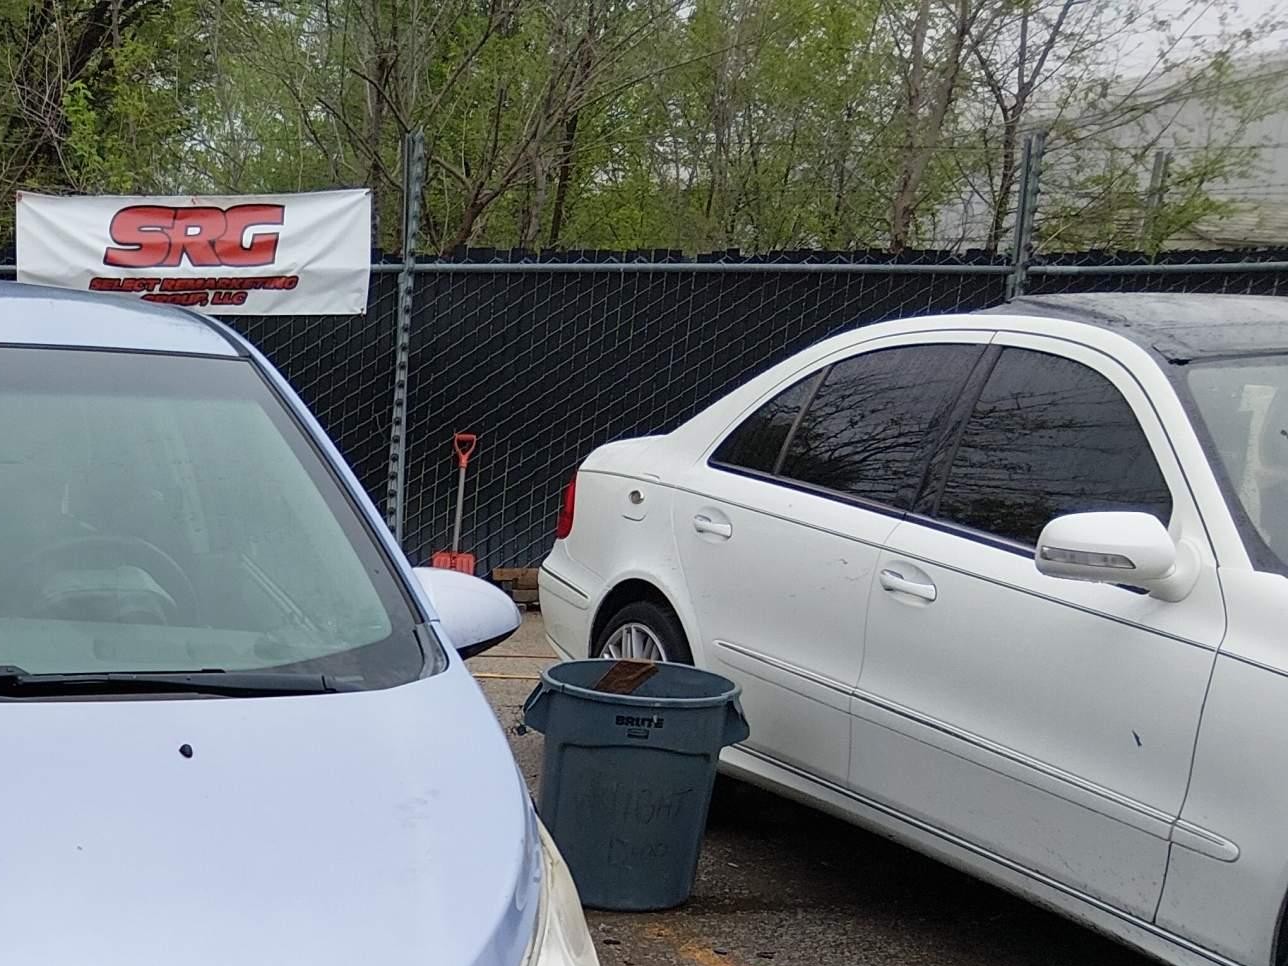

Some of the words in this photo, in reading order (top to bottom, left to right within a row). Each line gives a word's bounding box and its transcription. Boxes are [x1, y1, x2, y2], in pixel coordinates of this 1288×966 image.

[103, 204, 285, 268] SRG
[89, 277, 161, 291] SELECT
[159, 275, 299, 290] REMARKETING
[210, 291, 248, 305] LLC
[615, 715, 664, 728] BRUTE
